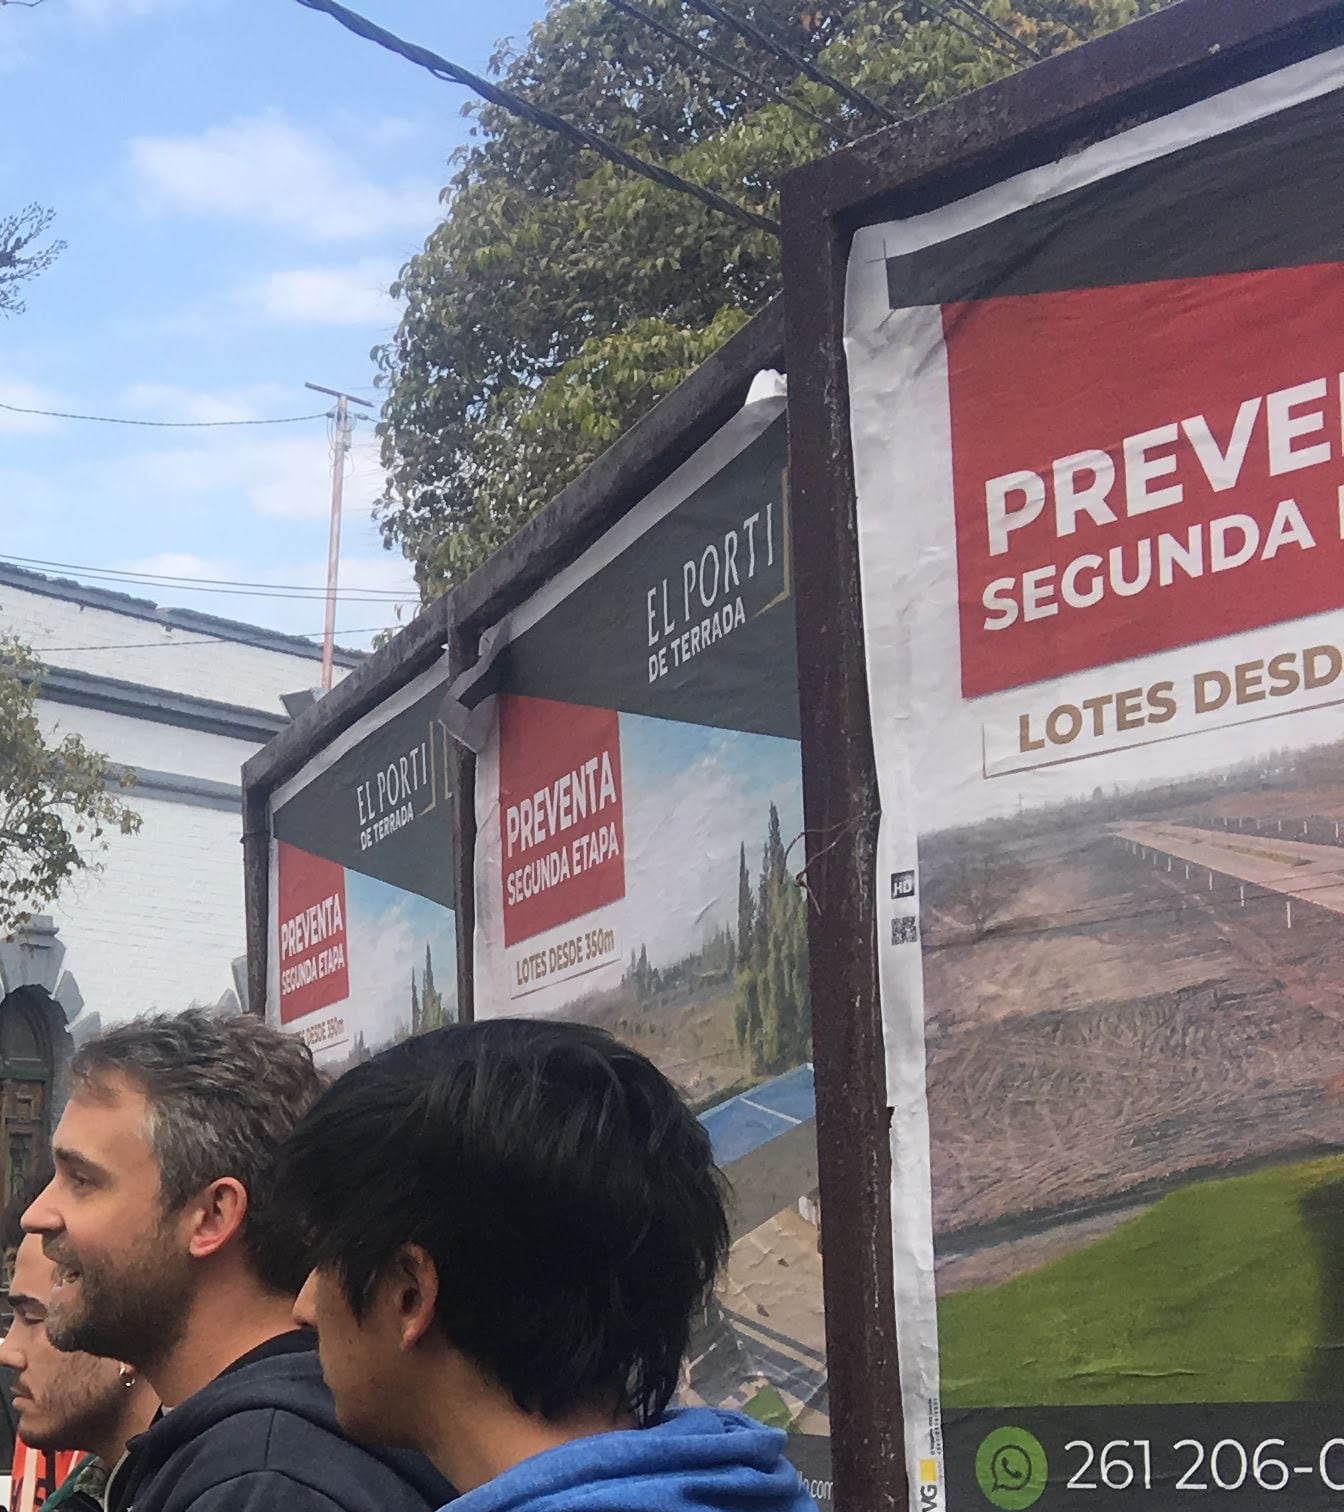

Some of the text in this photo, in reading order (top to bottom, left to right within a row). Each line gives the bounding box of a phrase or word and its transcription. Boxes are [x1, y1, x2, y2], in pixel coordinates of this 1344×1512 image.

[985, 372, 1344, 557] PREVE
[647, 502, 773, 647] EL PORTI
[982, 498, 1316, 631] SEGUNDA
[648, 596, 745, 683] DE TERRADA
[1019, 644, 1343, 753] LOTES DESD
[357, 742, 426, 826] EL PORTI
[360, 801, 413, 850] DE TERRADA
[506, 751, 616, 858] PREVENTA
[507, 822, 619, 907] SEGUNDA ETAPA
[281, 893, 343, 960] PREVENTA
[516, 951, 547, 986] LOTES
[549, 935, 583, 974] DESDE
[282, 943, 345, 995] SEGUNDA ETAPA
[920, 1484, 938, 1512] VG
[1064, 1440, 1151, 1490] 261
